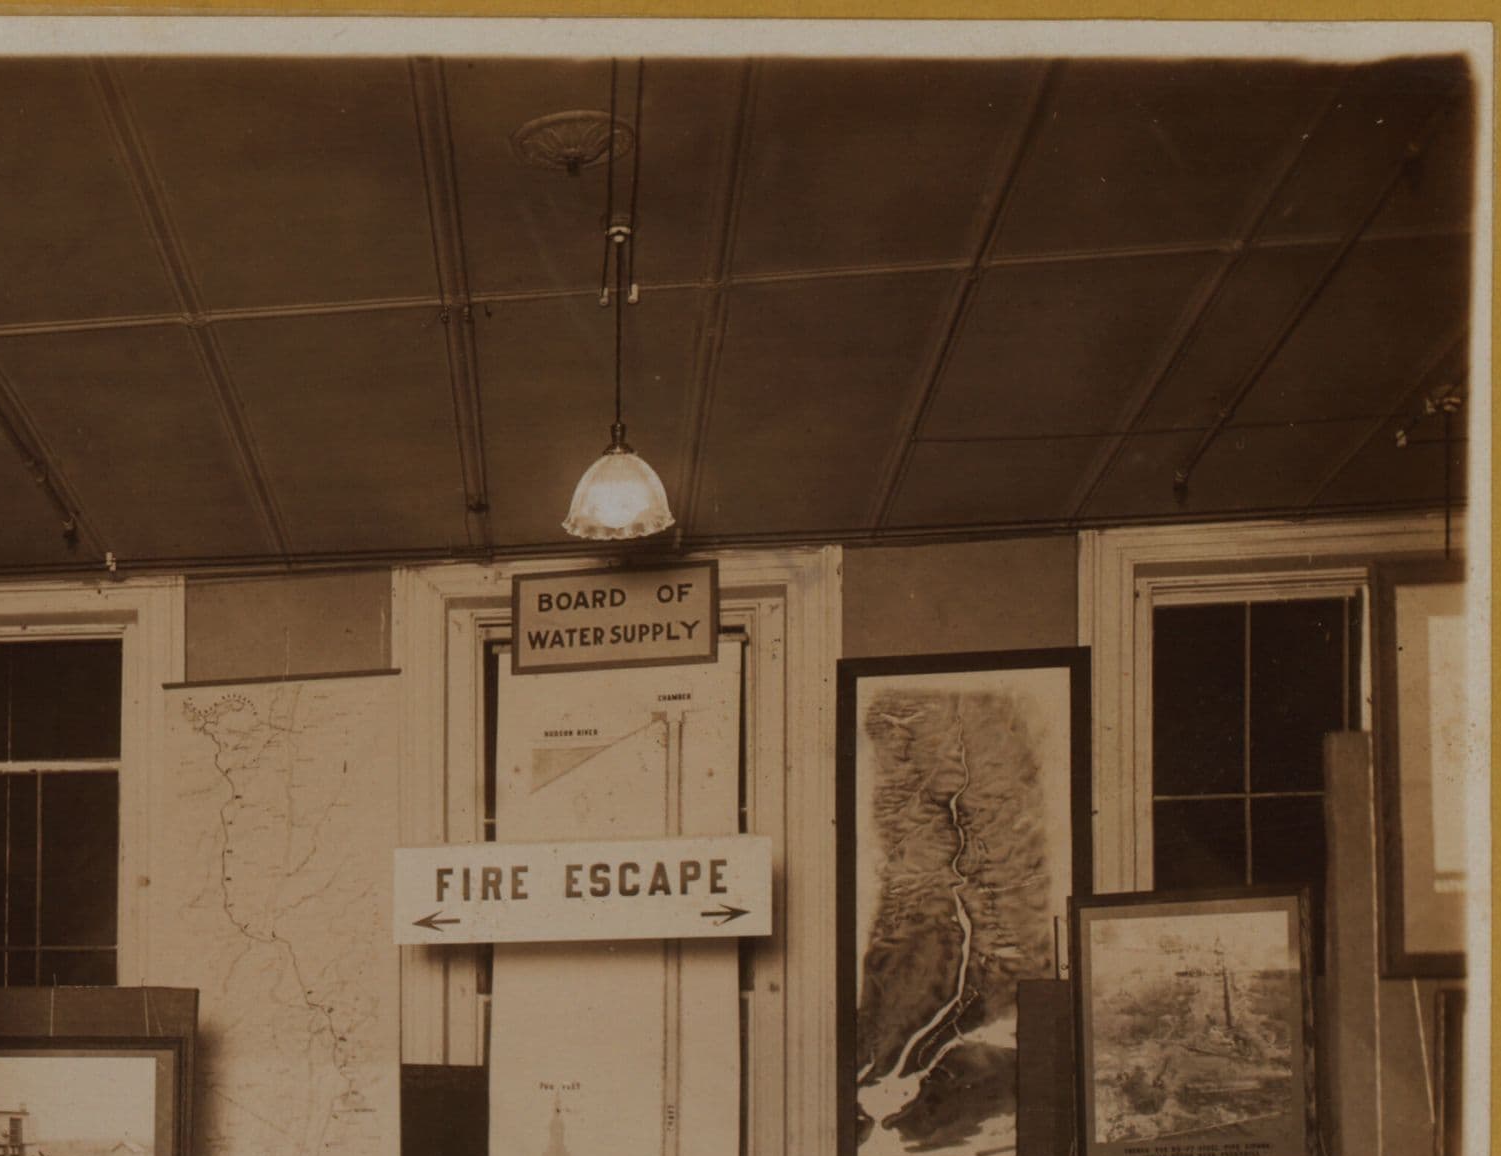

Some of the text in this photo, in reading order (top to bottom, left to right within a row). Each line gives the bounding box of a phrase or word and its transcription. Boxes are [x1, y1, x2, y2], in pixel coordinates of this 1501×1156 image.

[537, 583, 694, 613] BOARD OF
[527, 619, 700, 650] WATER SUPPLY
[657, 693, 692, 702] CHAMBER
[544, 728, 599, 738] HUDSON RIVER
[435, 858, 729, 902] FIRE ESCAPE
